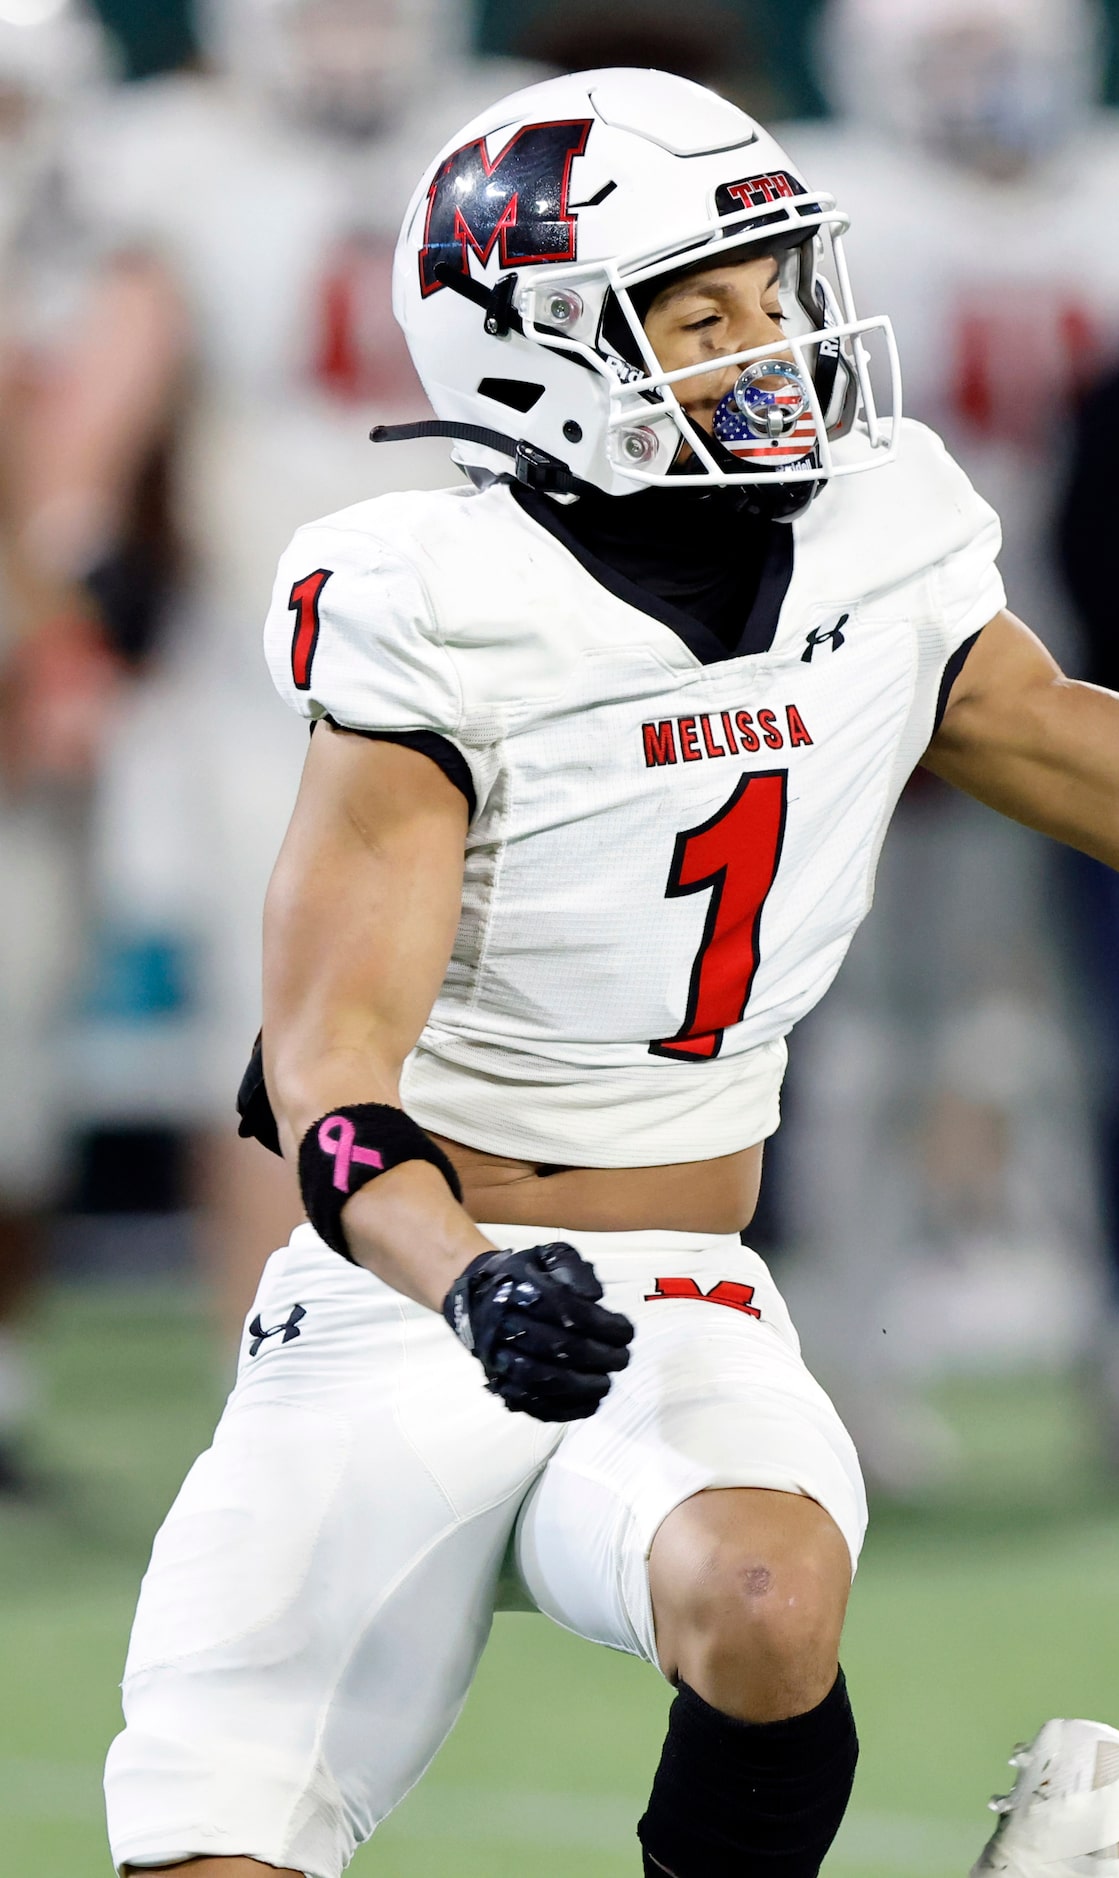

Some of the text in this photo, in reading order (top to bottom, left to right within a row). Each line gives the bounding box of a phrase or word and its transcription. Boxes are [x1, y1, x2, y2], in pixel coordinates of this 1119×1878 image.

[418, 118, 595, 299] M
[727, 173, 795, 209] TTH
[288, 567, 335, 691] 1
[641, 704, 814, 768] MELISSA
[648, 768, 789, 1062] 1
